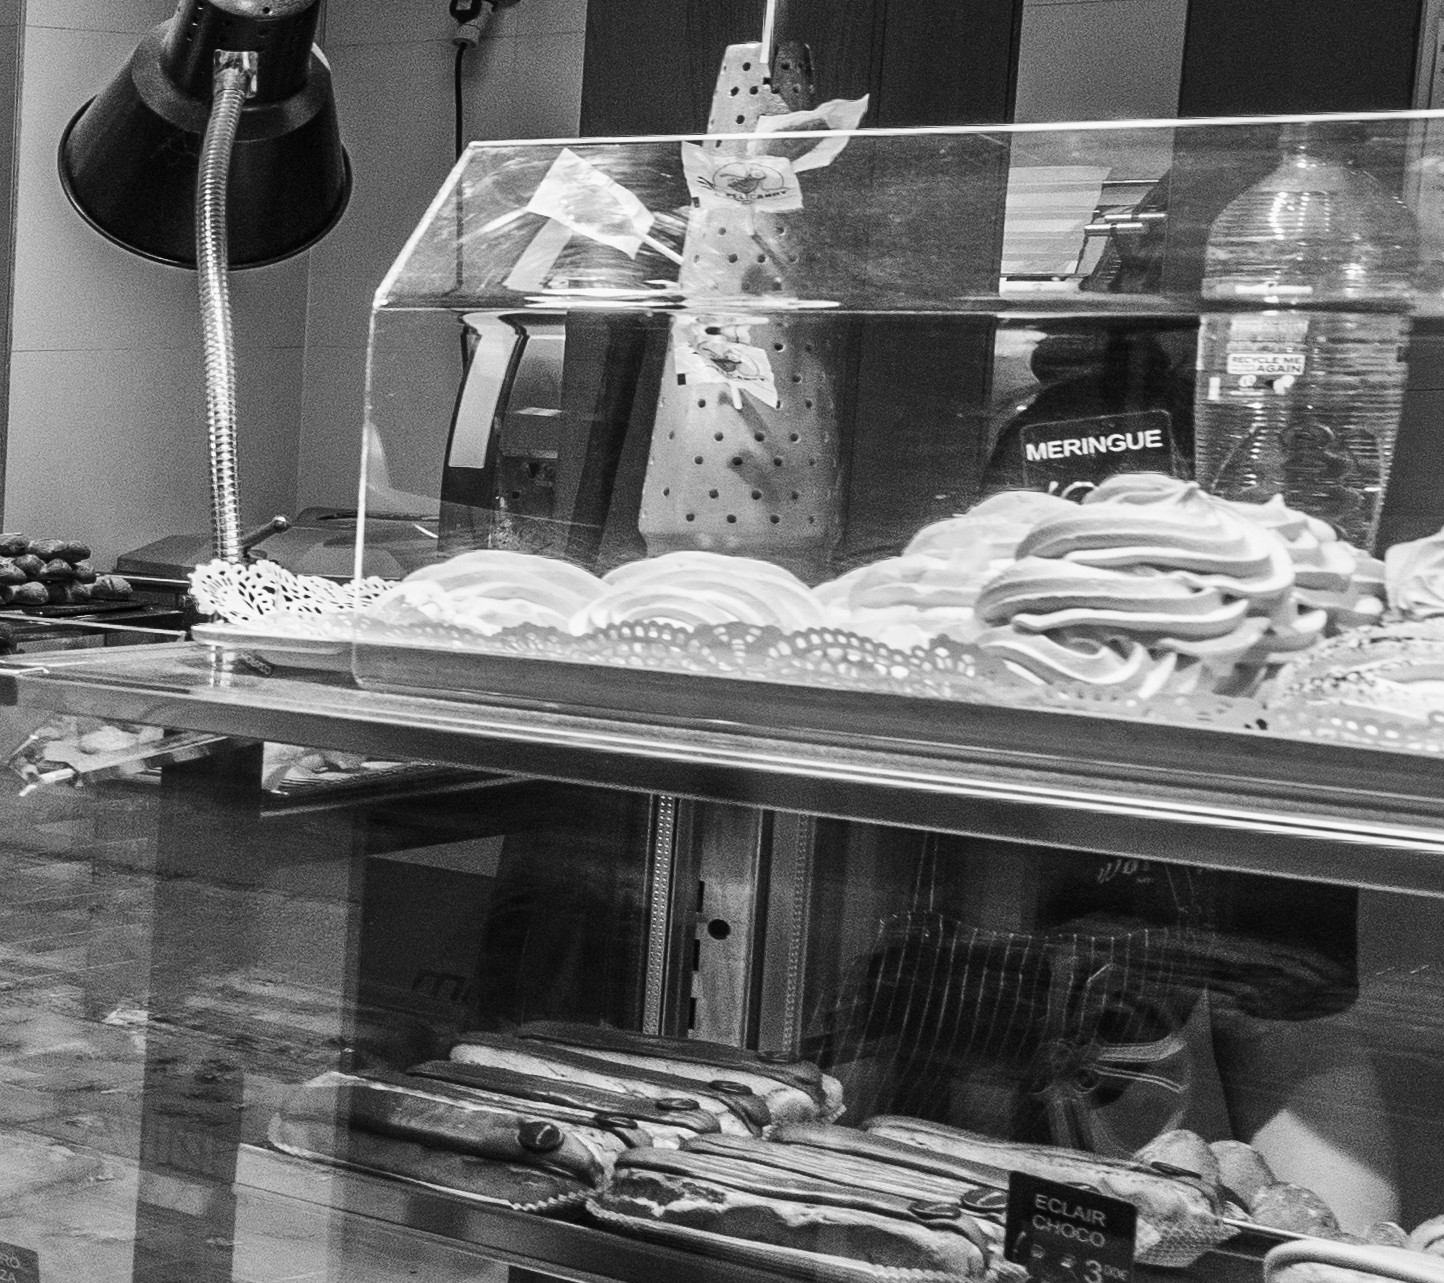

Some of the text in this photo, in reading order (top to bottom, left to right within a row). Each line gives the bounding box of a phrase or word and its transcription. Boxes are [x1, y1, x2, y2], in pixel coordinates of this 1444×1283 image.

[1257, 364, 1302, 374] AGAIN
[1025, 429, 1164, 462] MERINGUE
[1034, 1193, 1106, 1227] ECLAIR
[1031, 1214, 1106, 1248] CHOCO
